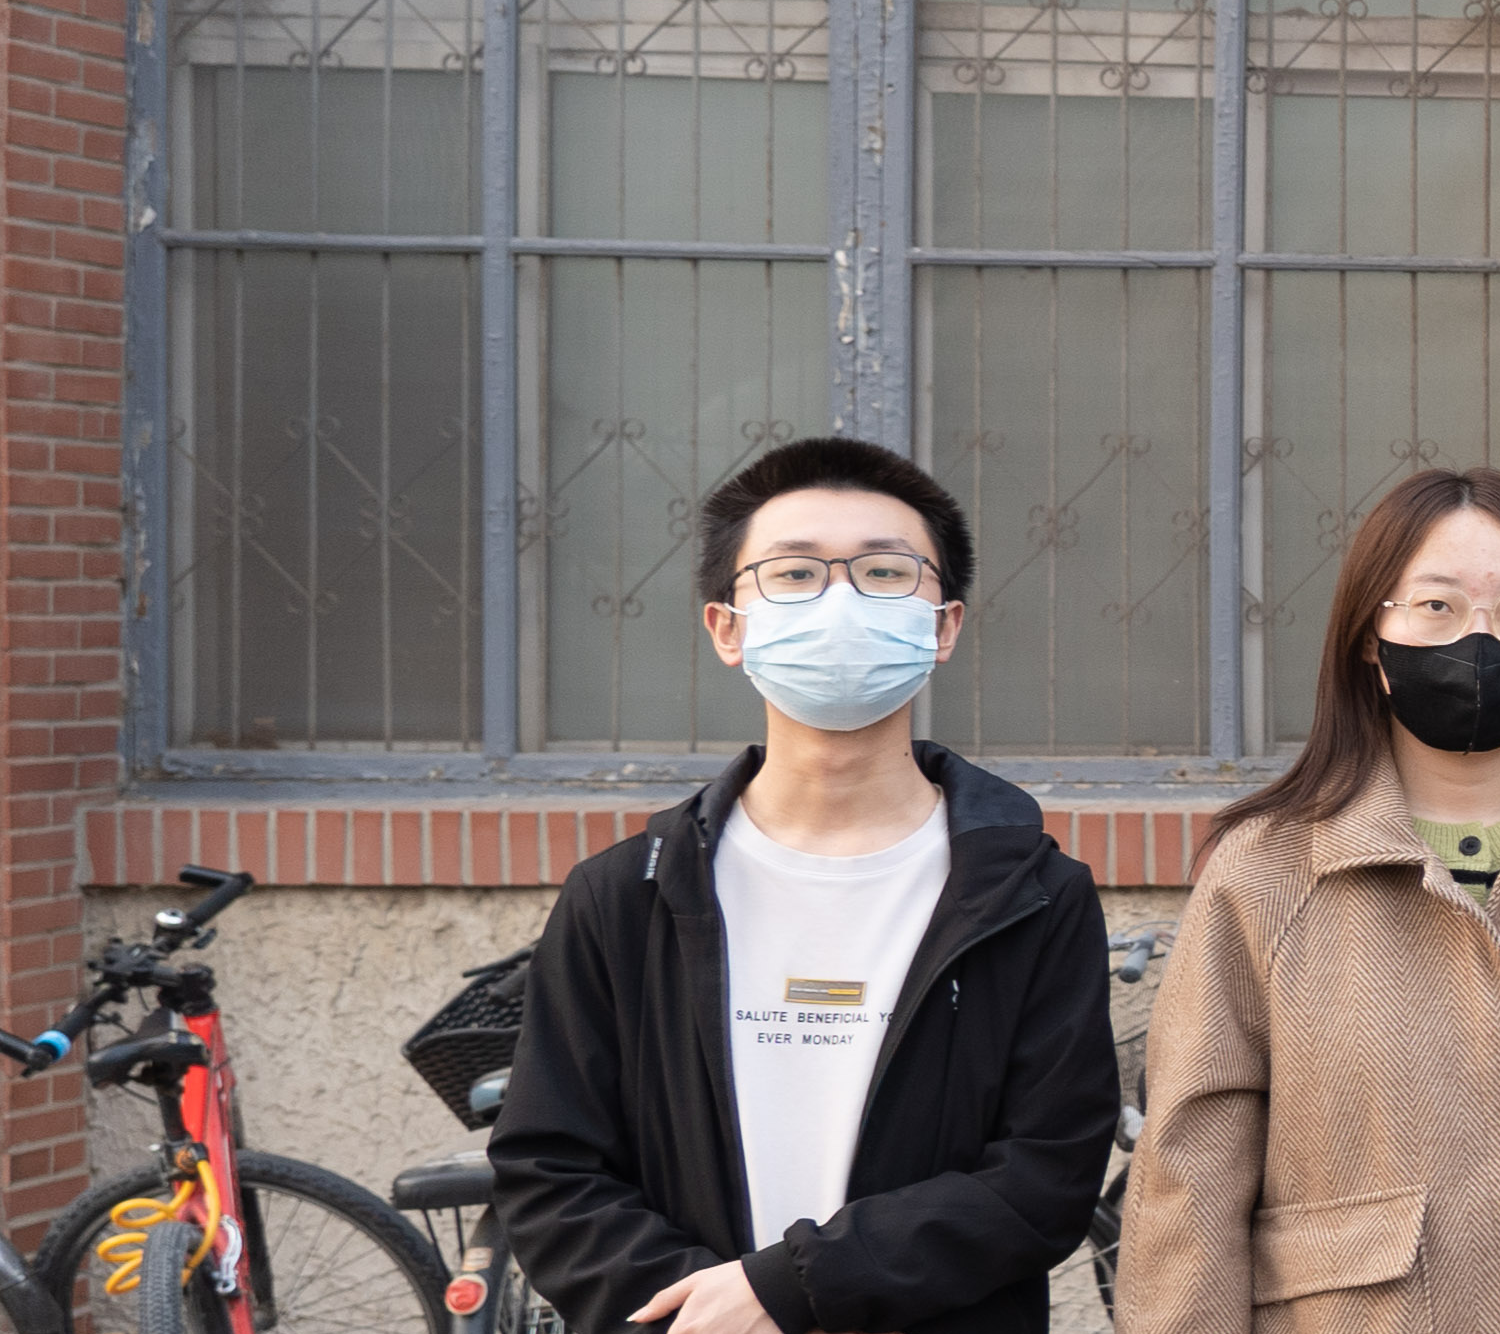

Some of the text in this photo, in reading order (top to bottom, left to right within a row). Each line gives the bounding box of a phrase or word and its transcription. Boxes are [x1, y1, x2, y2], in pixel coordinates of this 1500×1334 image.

[736, 1010, 788, 1023] SALUTE
[797, 1012, 870, 1024] BENEFICIAL
[757, 1033, 855, 1046] EVER MONDAY
